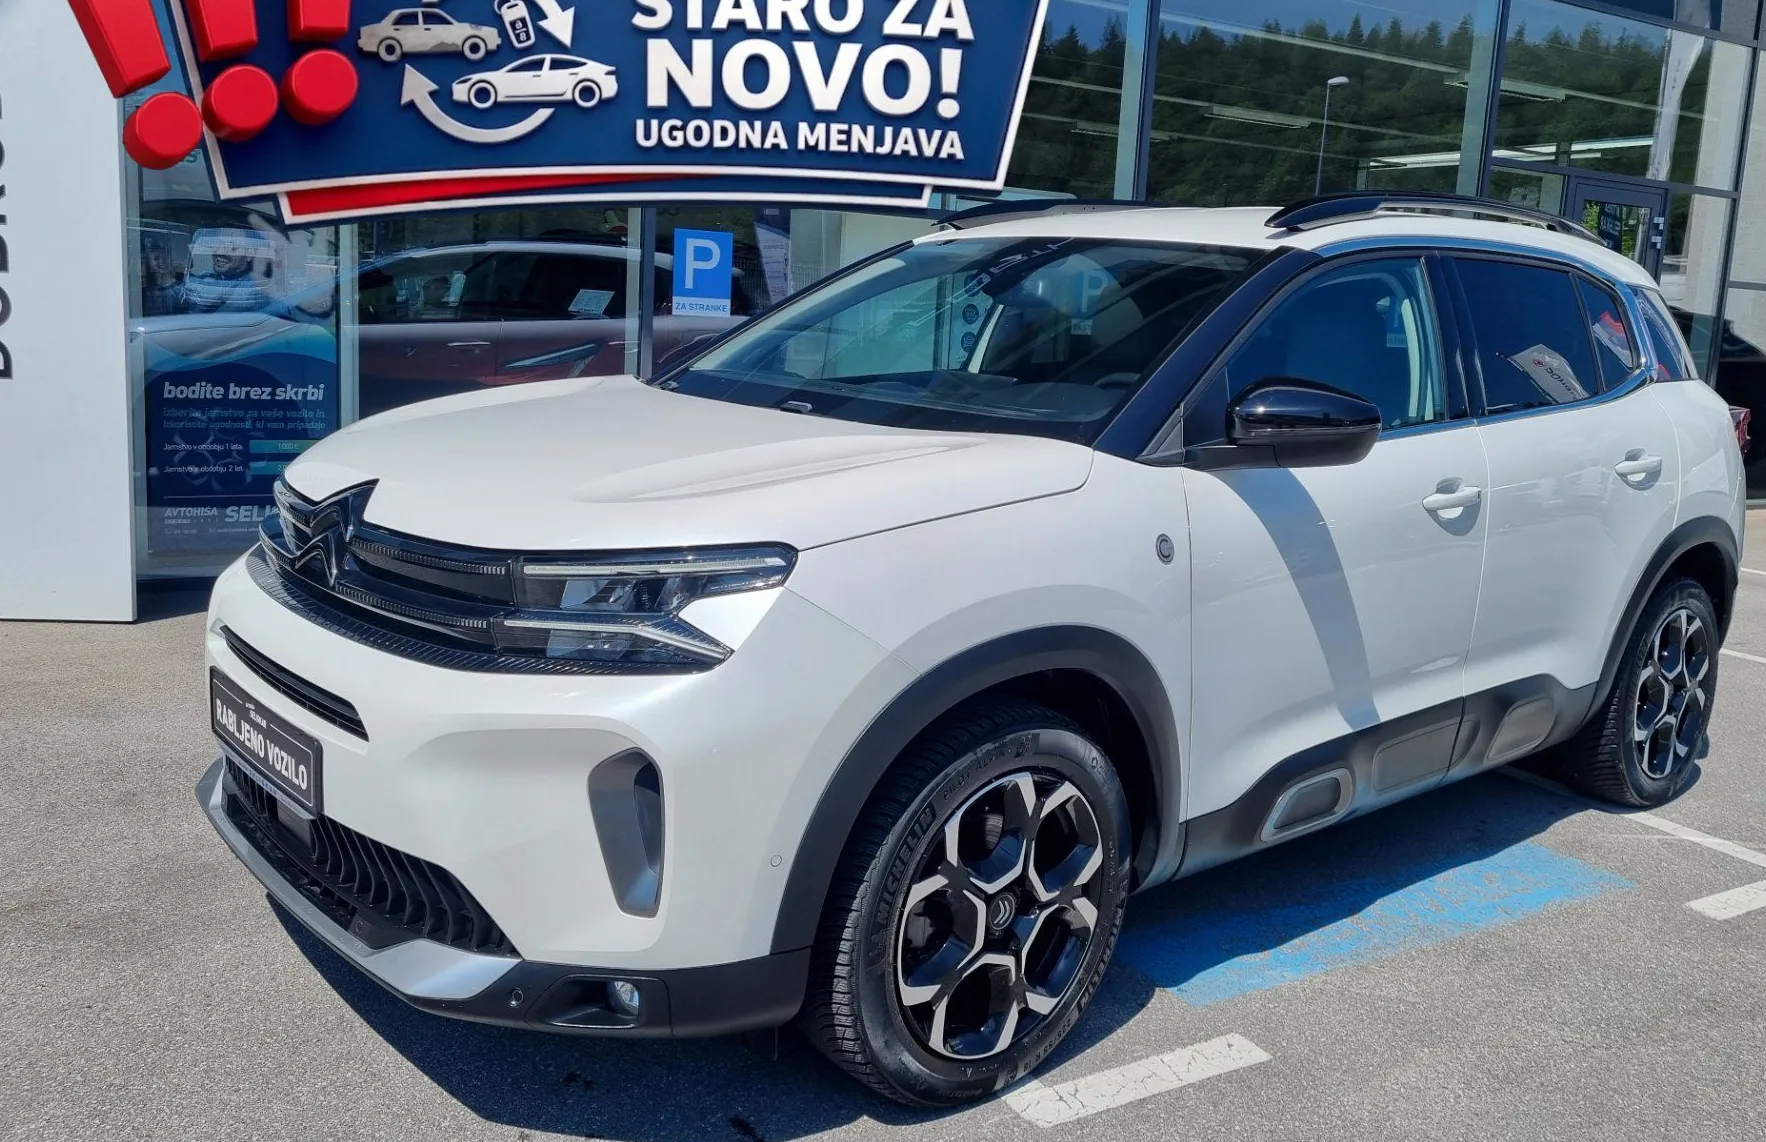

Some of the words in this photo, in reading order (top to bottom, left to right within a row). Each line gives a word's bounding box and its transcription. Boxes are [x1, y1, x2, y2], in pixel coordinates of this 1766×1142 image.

[685, 238, 721, 289] P
[675, 303, 687, 311] ZA
[688, 303, 728, 312] STRANKE
[163, 382, 225, 399] bodite
[228, 383, 273, 400] brez
[274, 384, 325, 401] skrbi
[216, 697, 265, 759] RABLJENO
[266, 739, 308, 791] VOZILO
